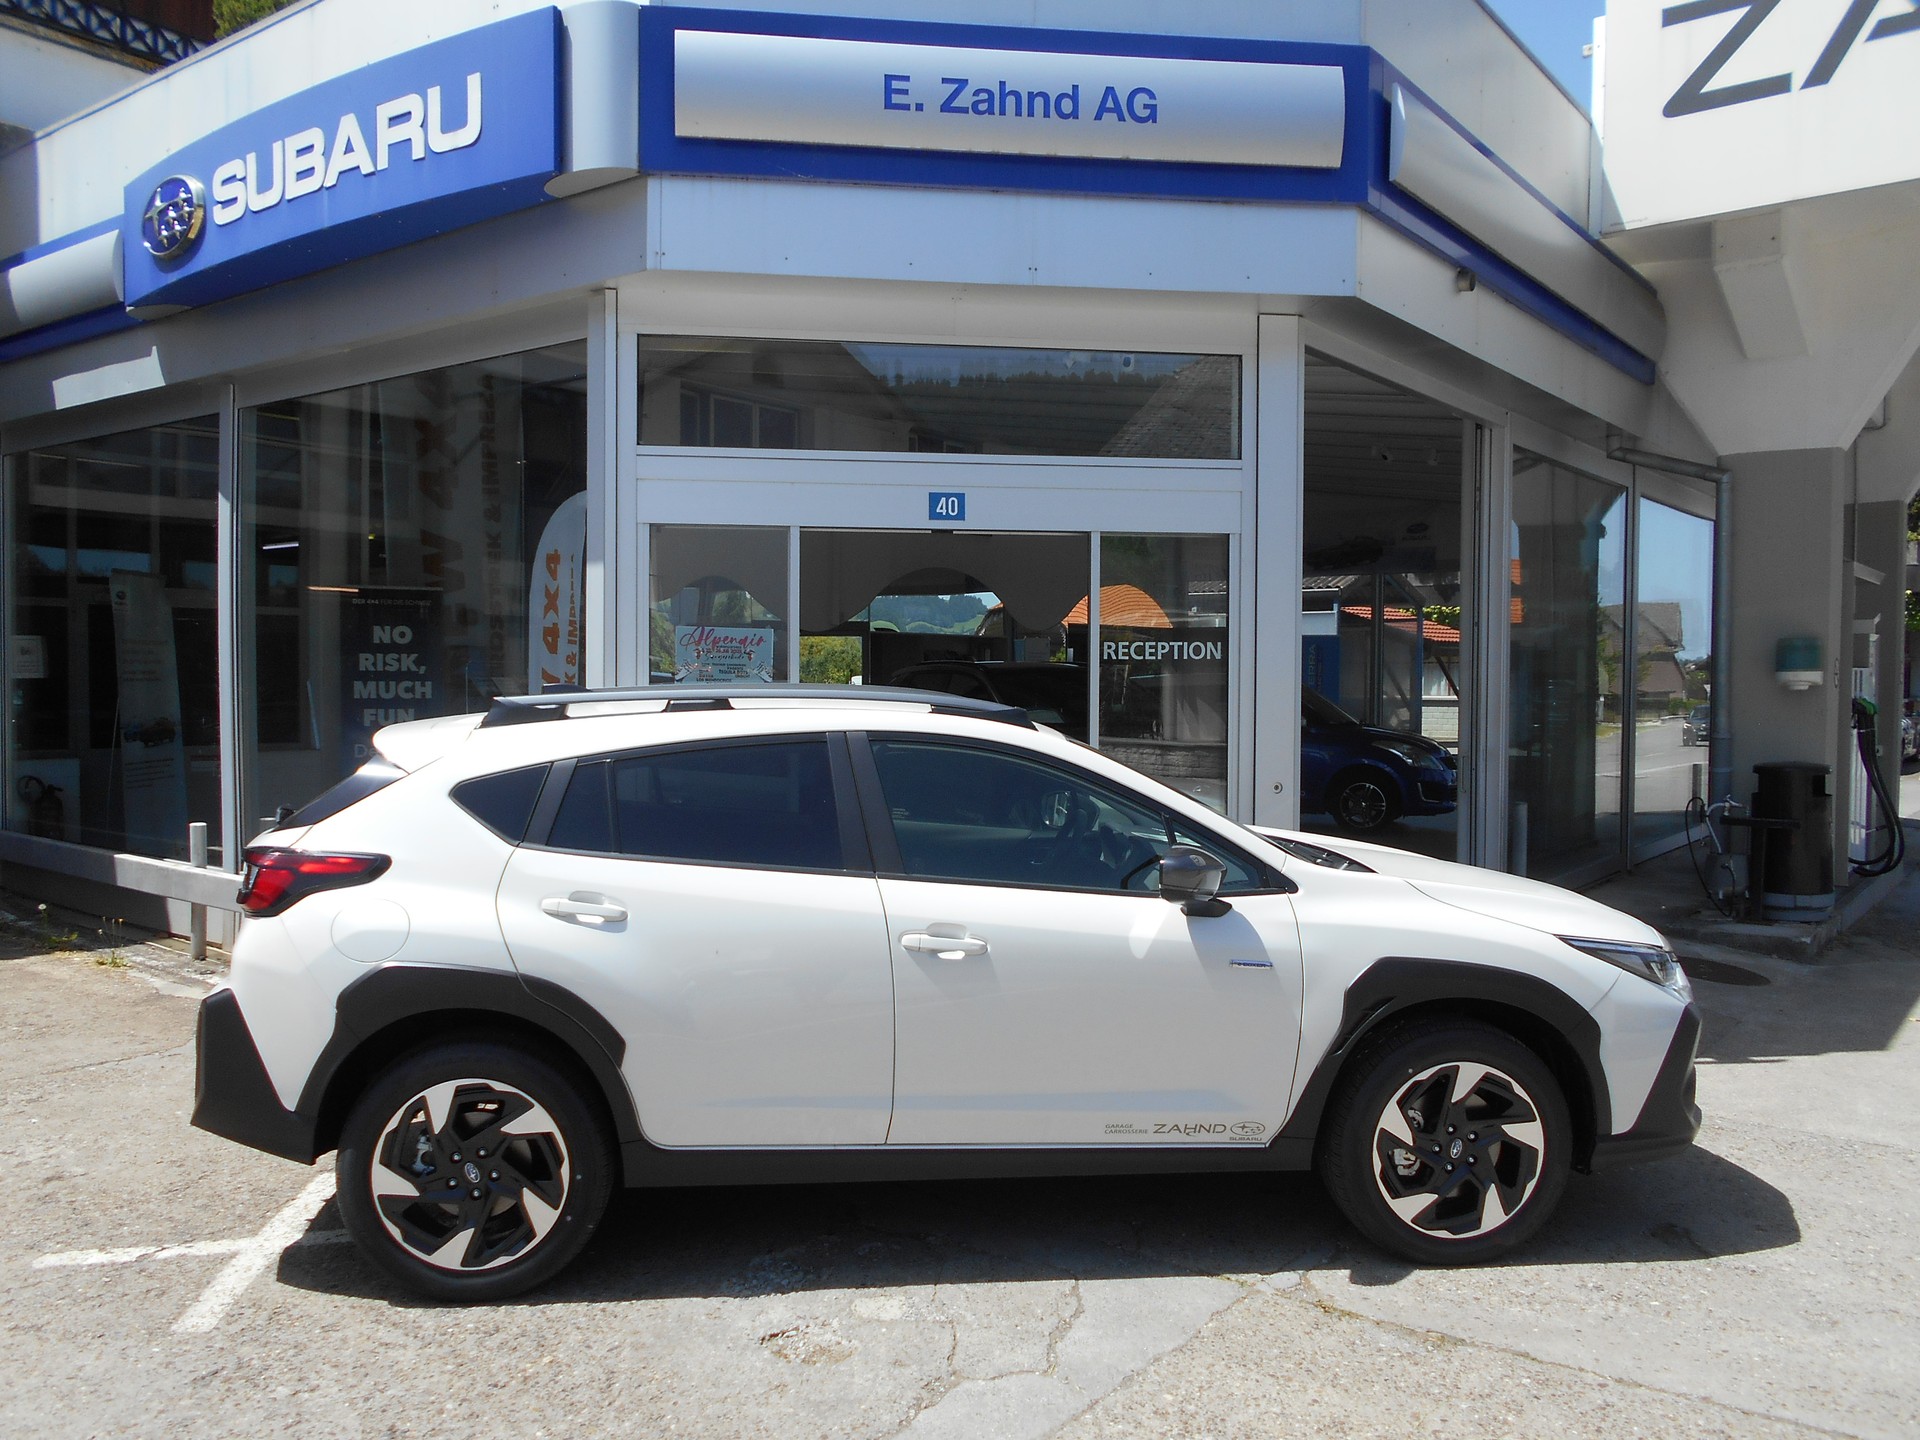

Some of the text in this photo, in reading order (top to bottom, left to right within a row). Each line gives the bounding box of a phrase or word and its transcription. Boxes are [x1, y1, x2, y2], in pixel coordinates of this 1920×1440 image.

[884, 74, 1158, 124] E. Zahnd AG
[212, 72, 482, 226] SUBARU
[936, 496, 959, 516] 40
[543, 549, 561, 655] 4X4
[373, 625, 413, 644] NO
[680, 626, 766, 652] Alpenair
[566, 650, 577, 667] &
[1103, 641, 1222, 661] RECEPTION
[359, 653, 427, 674] RISK,
[353, 680, 433, 699] MUCH
[363, 708, 415, 727] FUN
[1153, 1123, 1227, 1136] ZAHND
